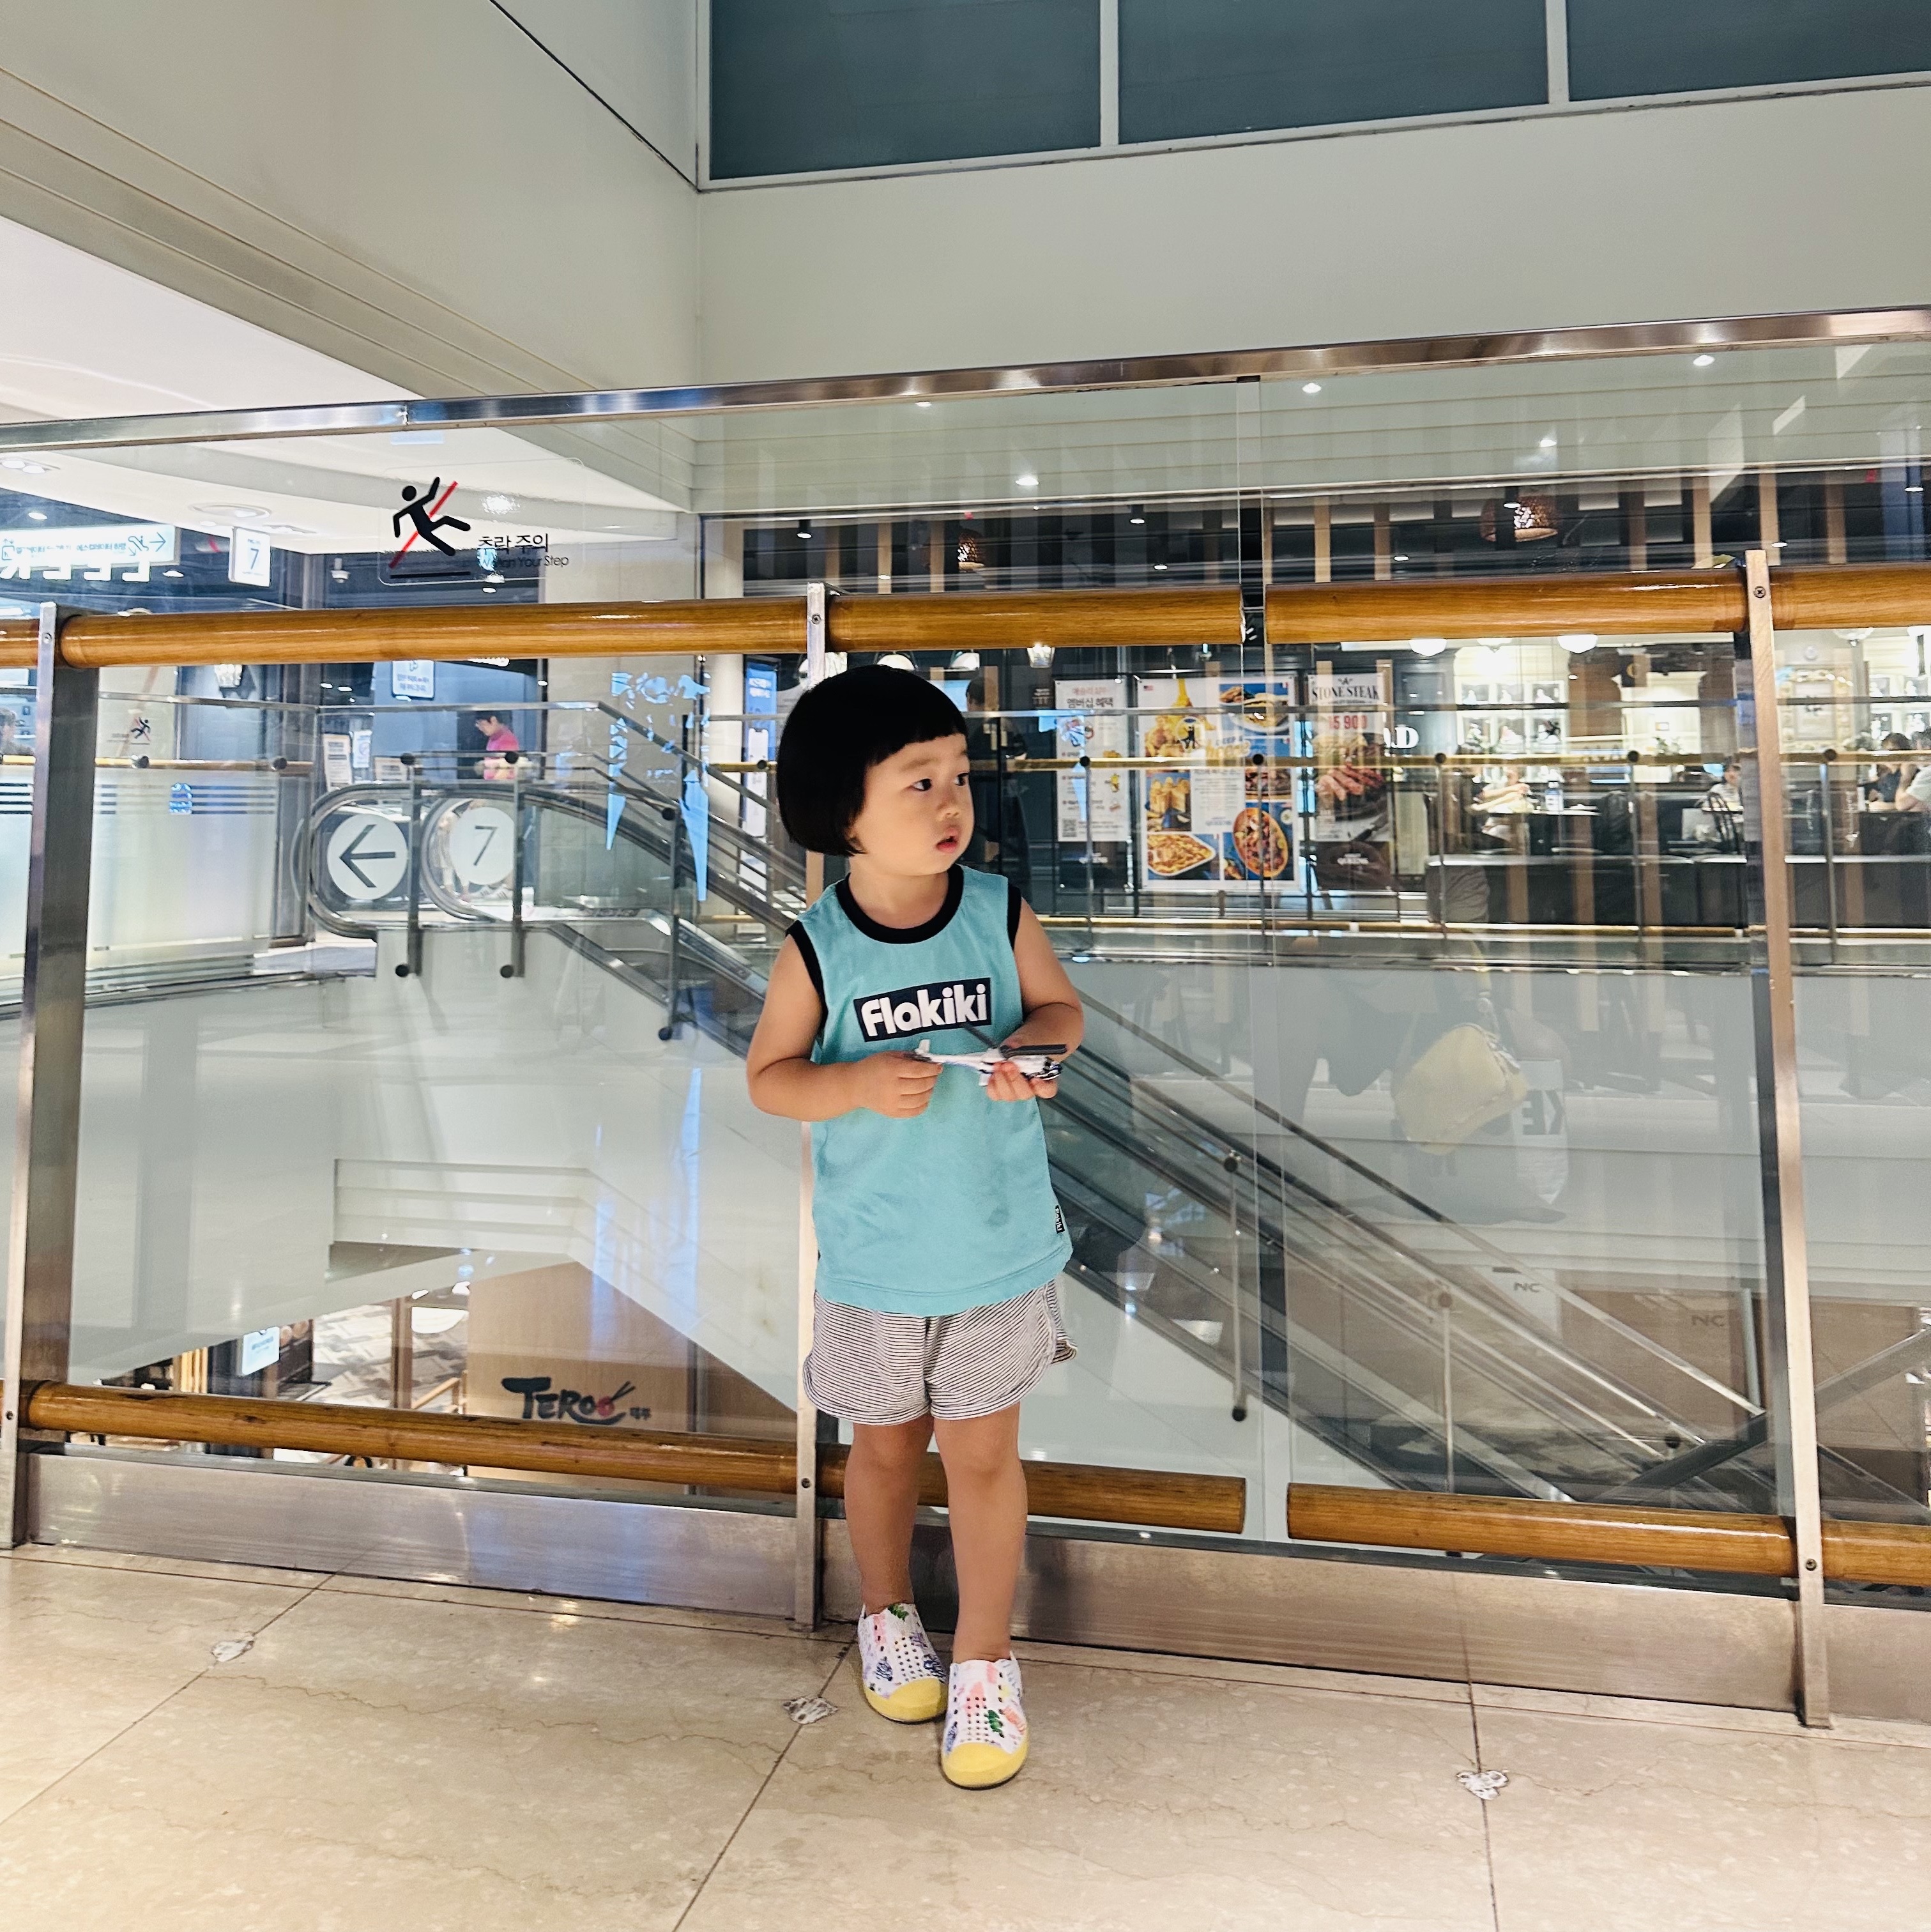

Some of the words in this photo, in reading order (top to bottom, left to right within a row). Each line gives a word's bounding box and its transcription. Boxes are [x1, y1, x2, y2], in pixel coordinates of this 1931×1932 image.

[478, 535, 511, 555] 추락
[514, 533, 548, 554] 주의
[250, 548, 259, 570] 7
[518, 556, 542, 567] Your
[544, 555, 569, 567] Step
[1312, 686, 1345, 701] STONE
[1347, 686, 1380, 700] STEAK
[475, 825, 499, 866] 7
[1513, 1282, 1541, 1292] NC
[1691, 1315, 1725, 1328] NC
